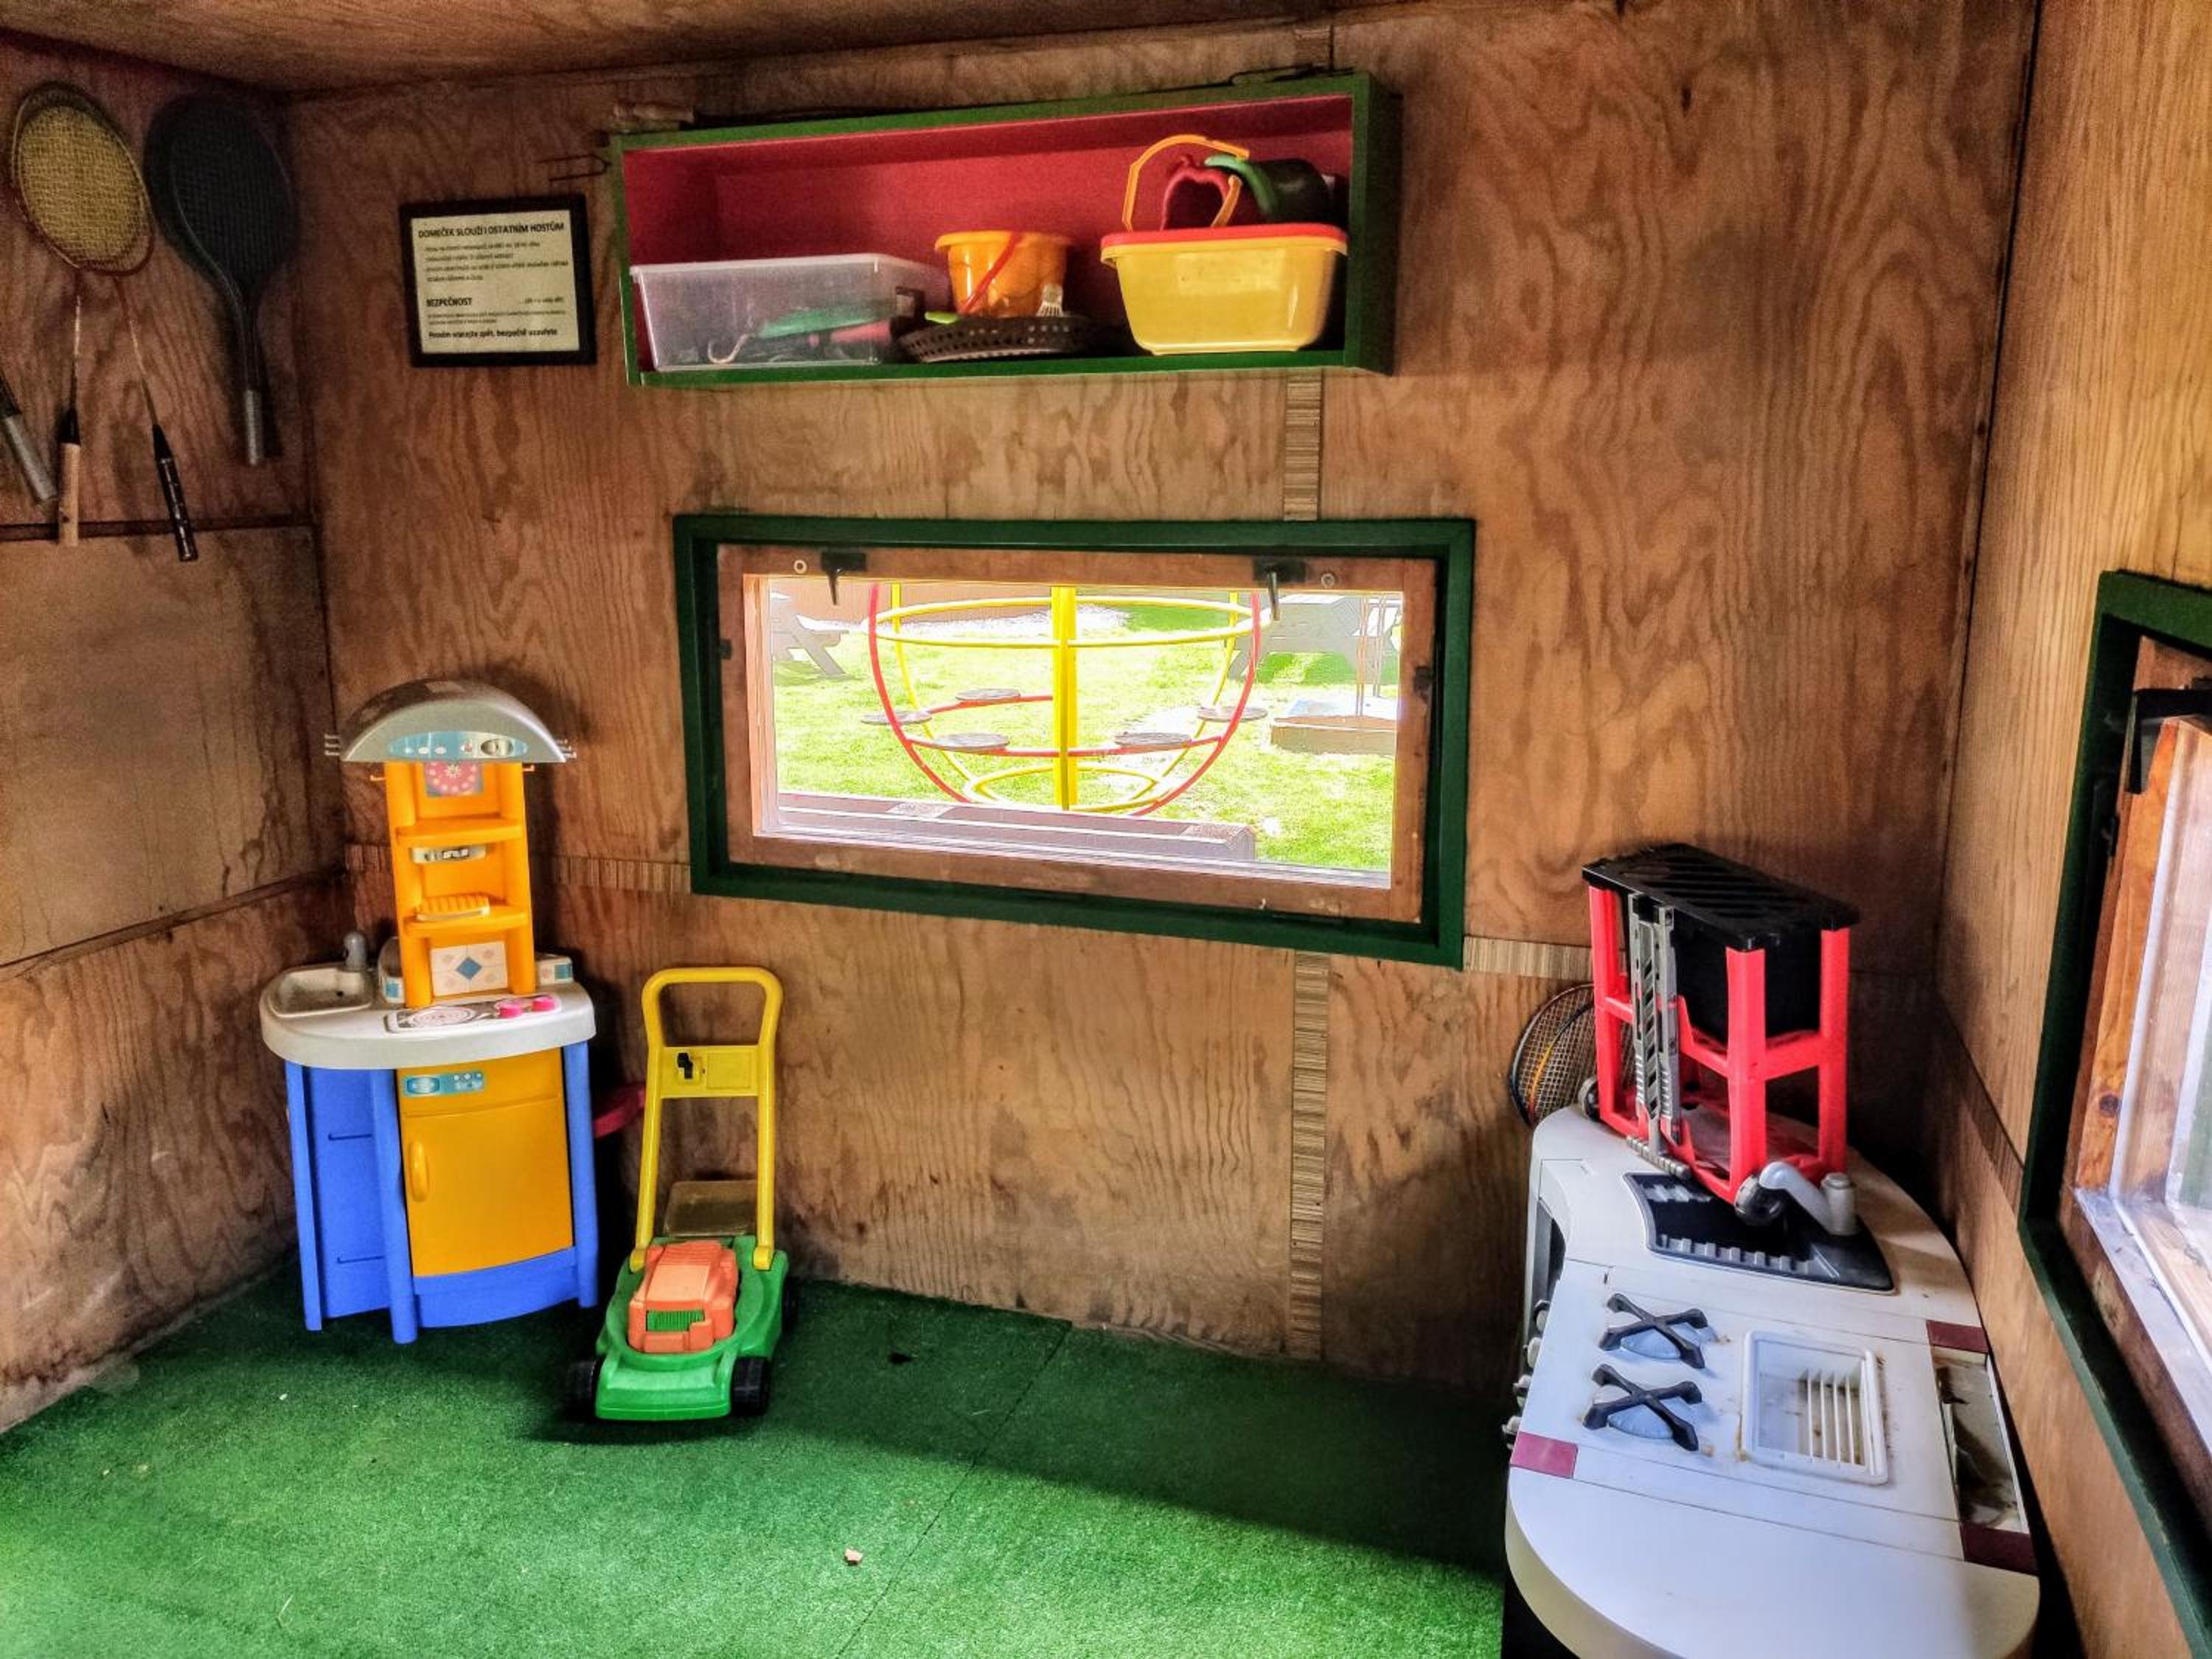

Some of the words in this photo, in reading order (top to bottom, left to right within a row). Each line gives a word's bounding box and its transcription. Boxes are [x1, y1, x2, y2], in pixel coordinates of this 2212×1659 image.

[418, 227, 455, 238] DOMEČEK
[488, 222, 529, 234] OSTATNÍM
[531, 220, 564, 232] HOSTŮM
[426, 296, 472, 307] BEZPEČNOST
